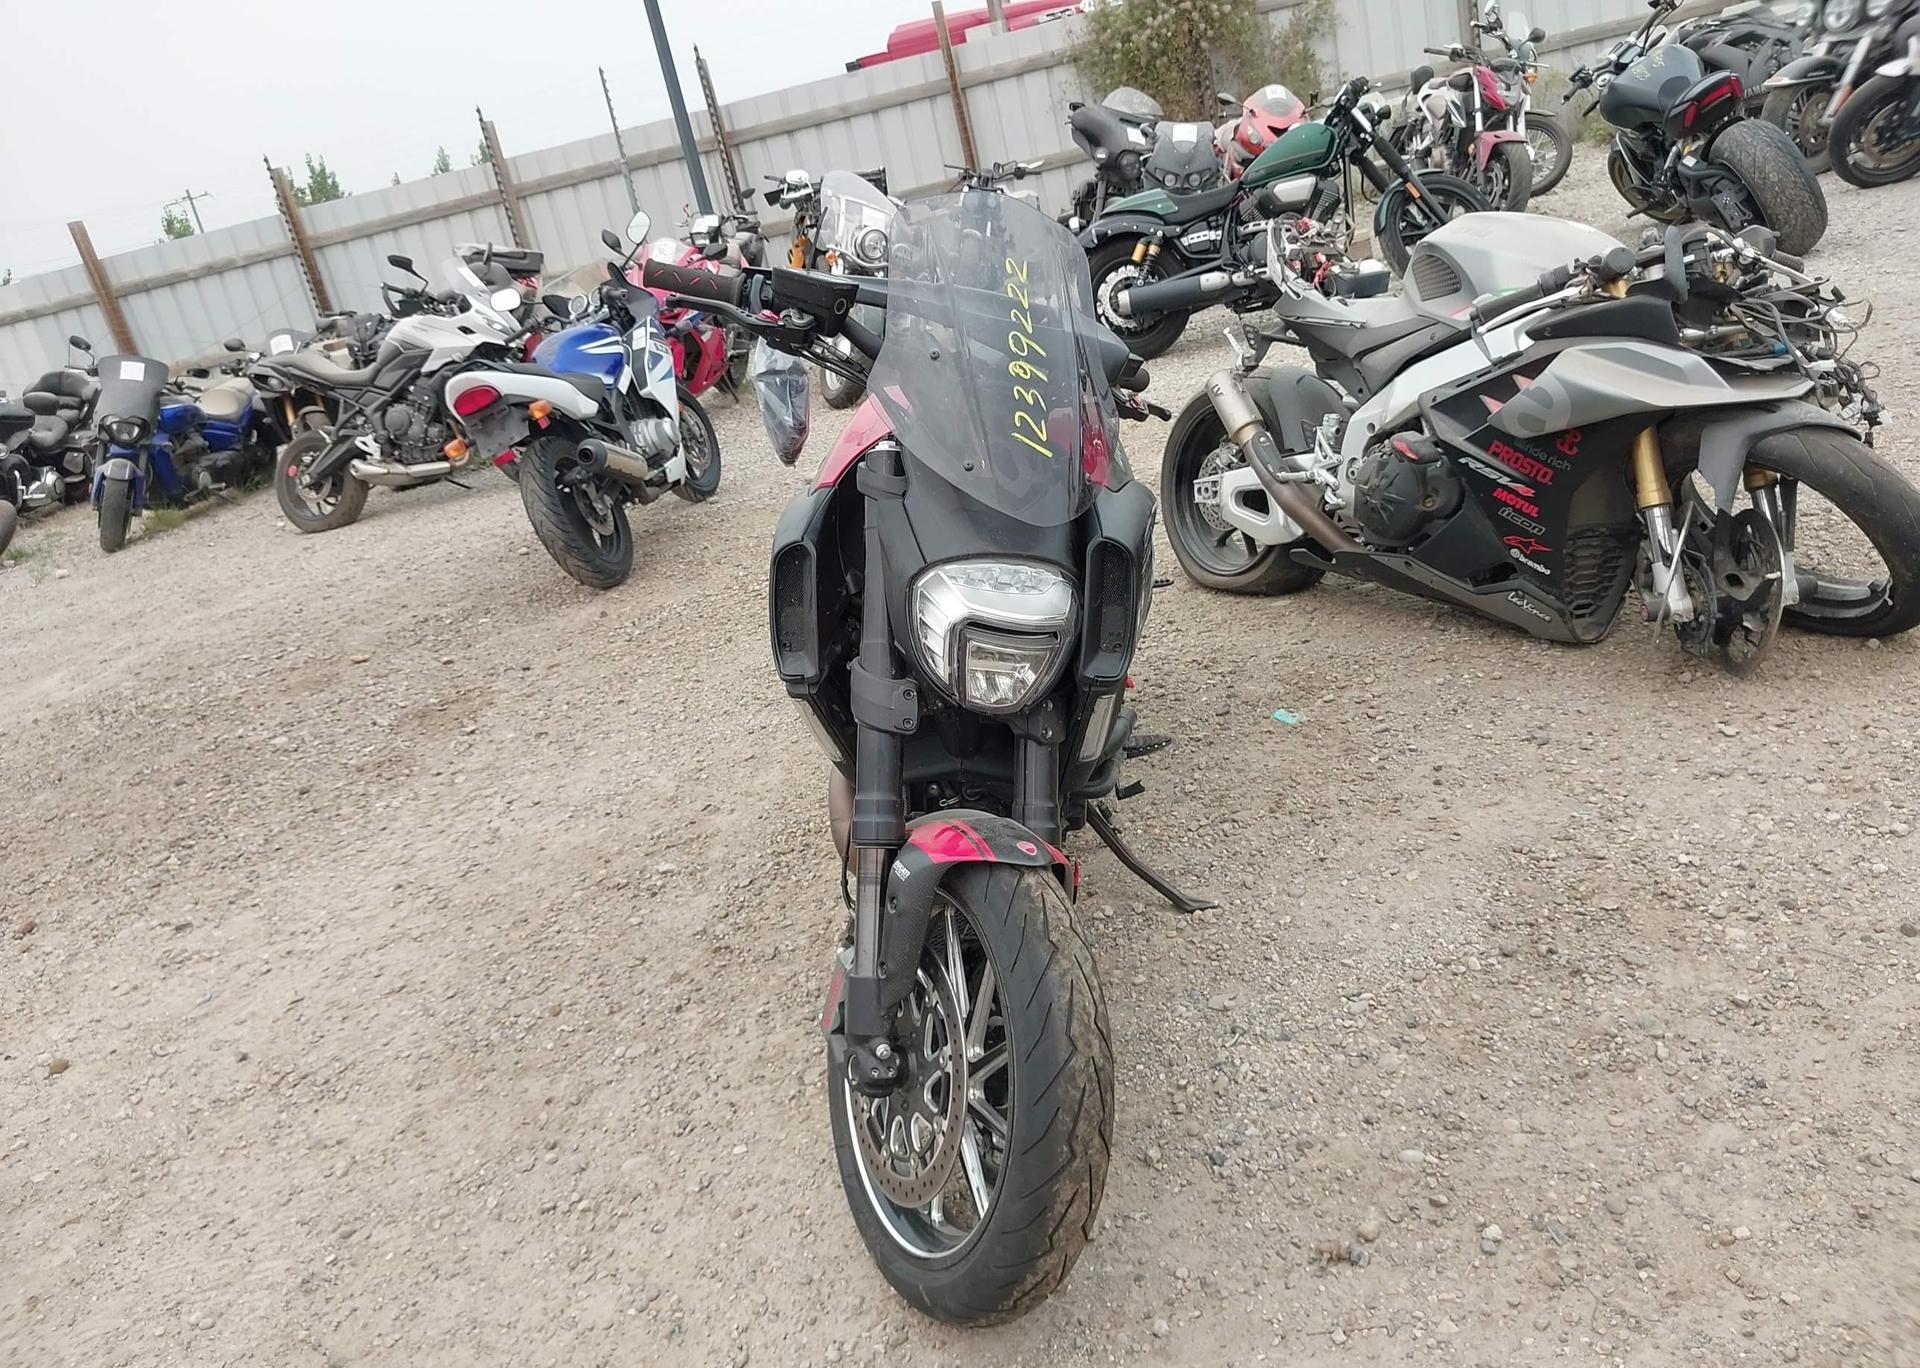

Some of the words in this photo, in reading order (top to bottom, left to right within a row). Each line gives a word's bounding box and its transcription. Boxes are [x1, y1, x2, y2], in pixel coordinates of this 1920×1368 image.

[1005, 257, 1054, 459] 12399222
[1547, 455, 1572, 472] rich
[1493, 487, 1539, 518] MOTUL
